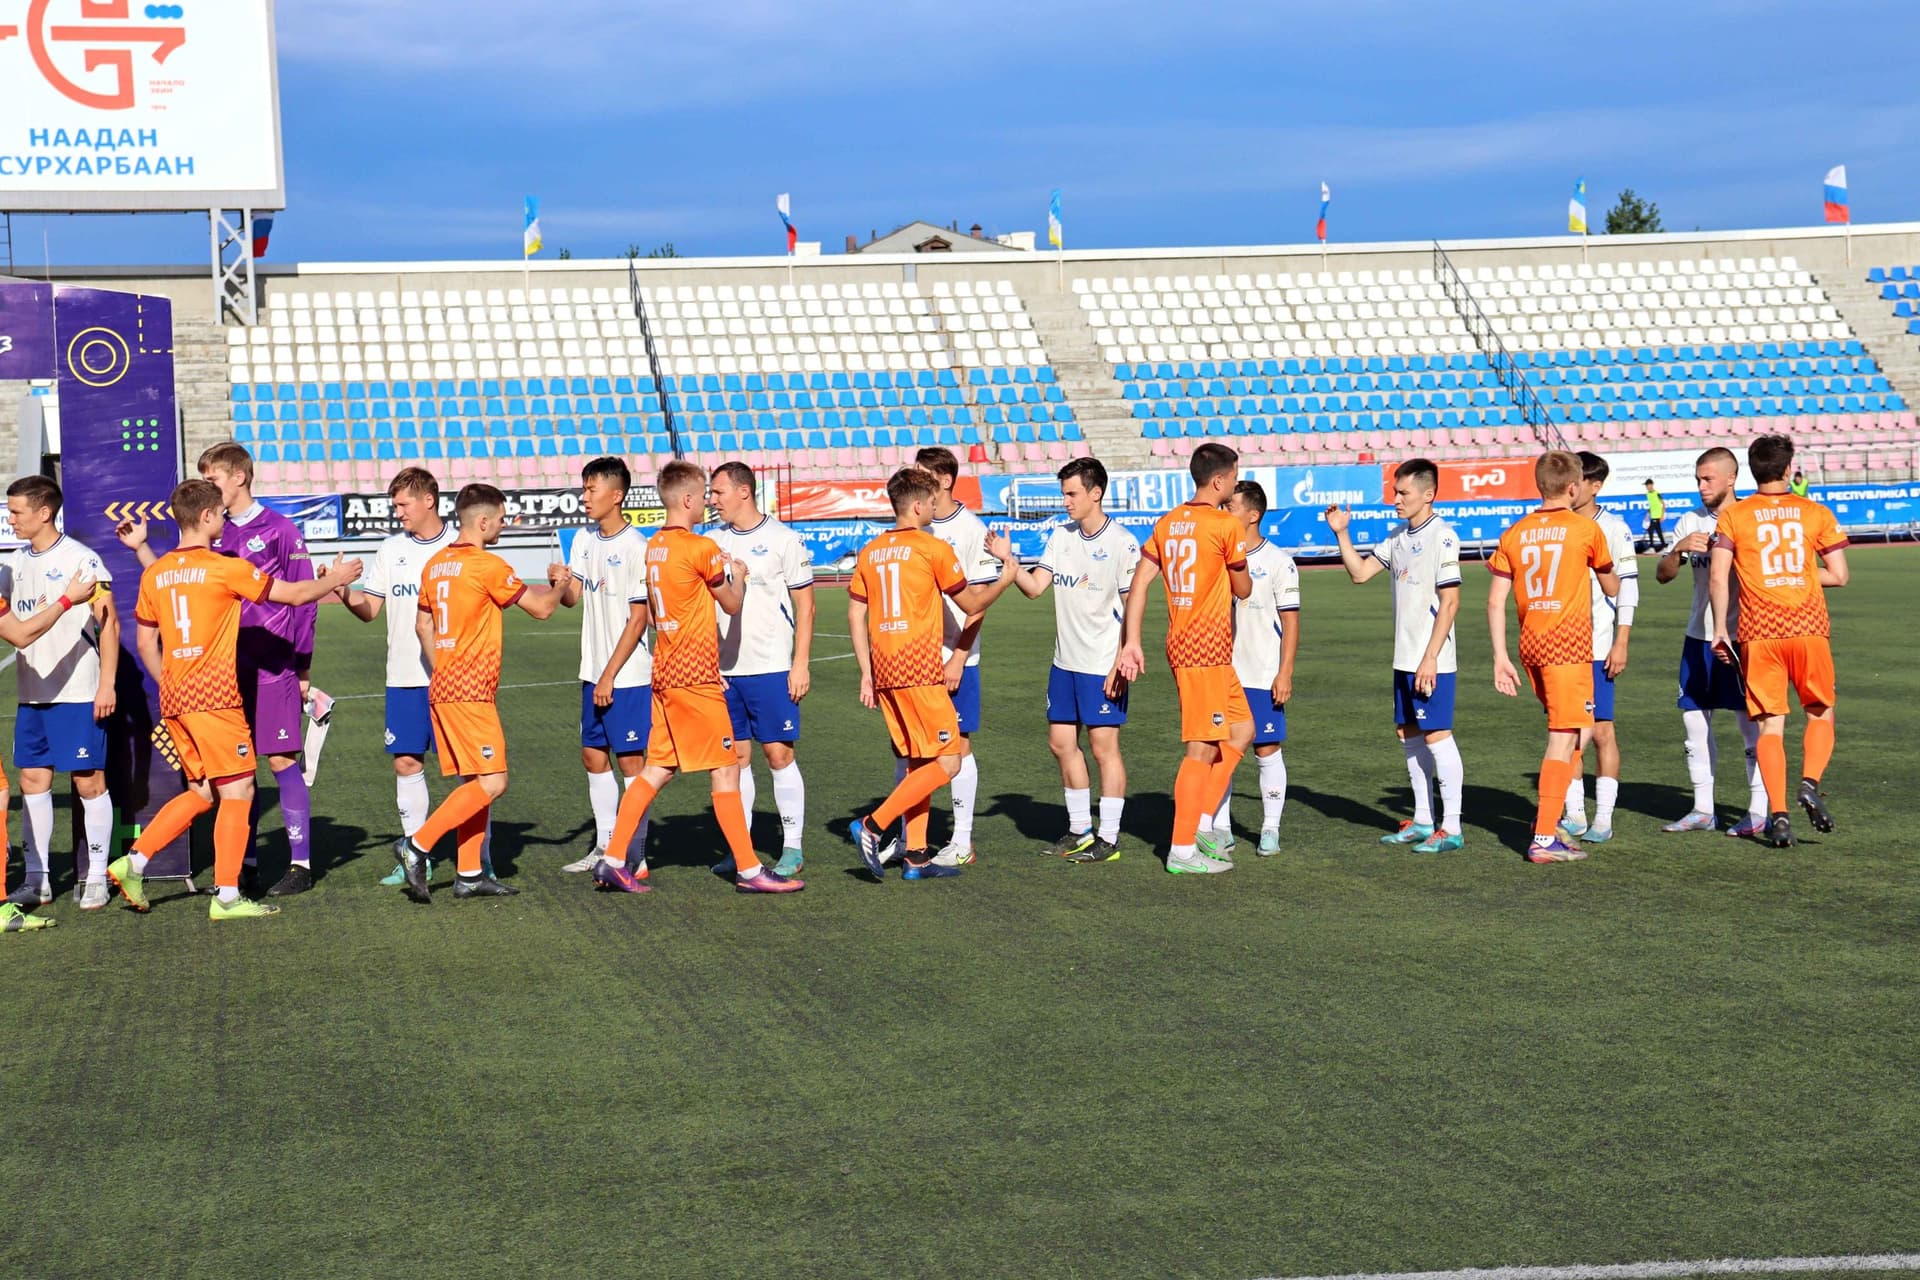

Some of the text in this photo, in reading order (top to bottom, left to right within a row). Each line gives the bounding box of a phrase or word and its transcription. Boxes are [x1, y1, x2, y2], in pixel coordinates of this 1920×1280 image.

[29, 128, 157, 151] НААДАН
[0, 156, 194, 175] СУРХАРБААН
[1314, 490, 1363, 504] ГАЗПРОМ
[1827, 489, 1908, 500] РЕСПУБЛИКА
[1458, 505, 1523, 517] ДАЛЬНЕГО
[1754, 507, 1800, 522] ВОРОНА
[1520, 526, 1567, 544] ЖДАНОВ
[869, 545, 911, 566] РОДИЧЕВ
[1757, 521, 1805, 575] 23
[1164, 538, 1197, 593] 22
[1521, 543, 1563, 599] 27
[155, 567, 207, 590] МАТЫЦИН
[1052, 573, 1079, 588] GNV
[876, 562, 901, 619] 11
[170, 588, 191, 644] 4
